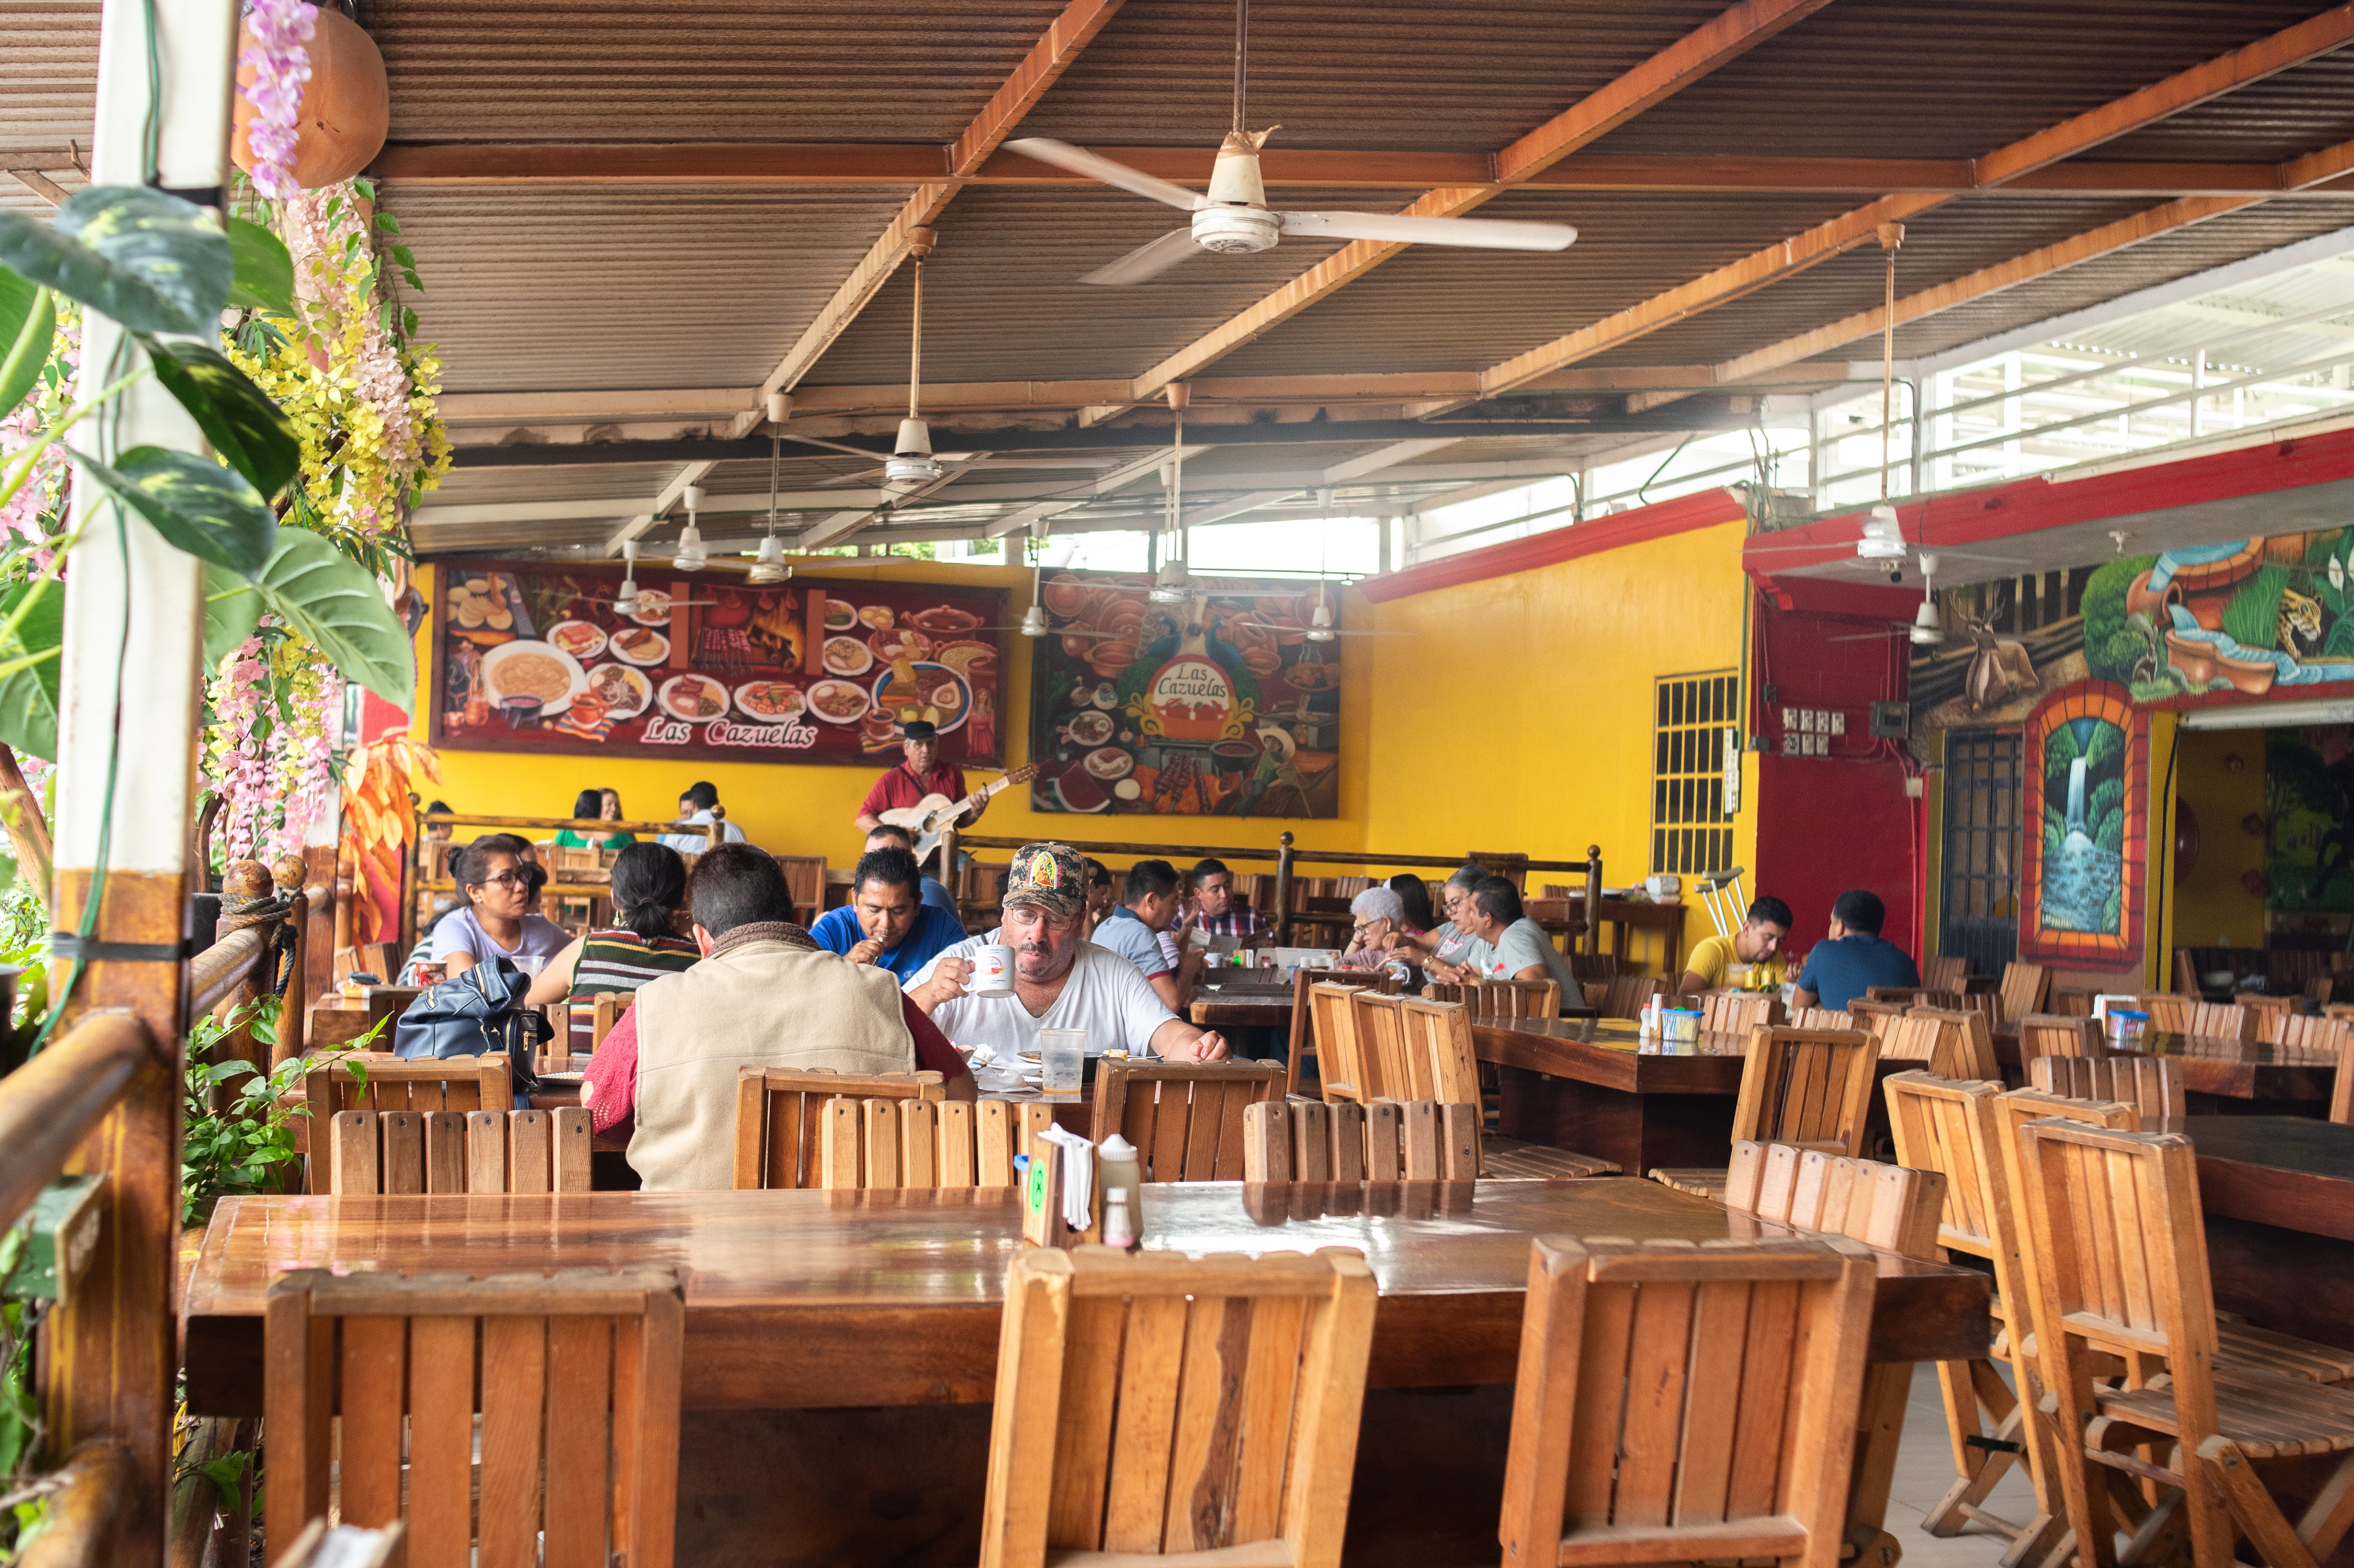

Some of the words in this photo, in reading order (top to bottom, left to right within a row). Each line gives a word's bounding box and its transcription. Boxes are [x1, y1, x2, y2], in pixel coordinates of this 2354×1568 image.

[1177, 664, 1207, 681] Las
[1158, 677, 1226, 697] Cazuelas
[642, 717, 691, 743] Las
[707, 717, 817, 746] Cazuelas
[1031, 1169, 1043, 1208] 18
